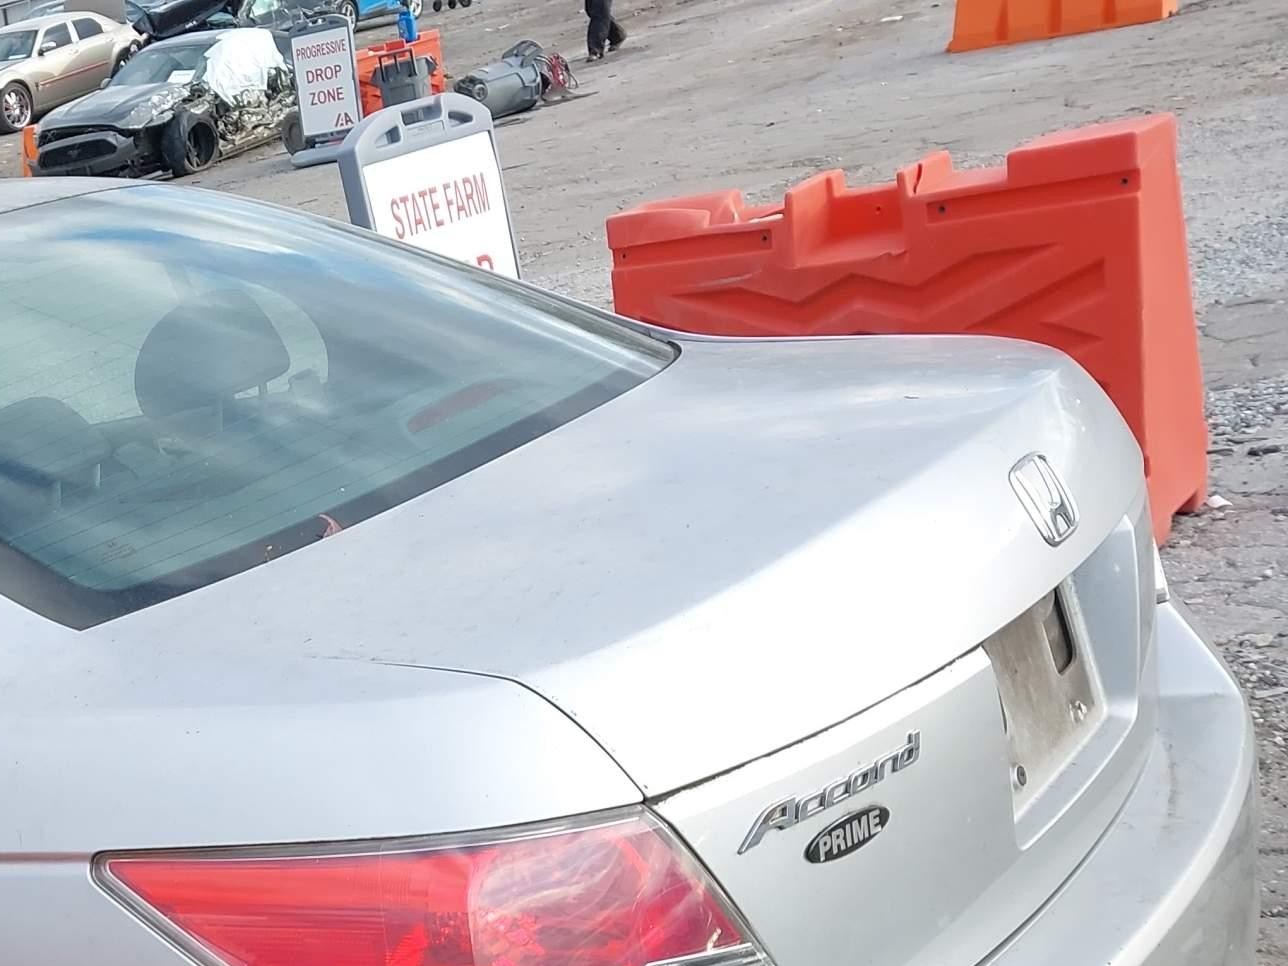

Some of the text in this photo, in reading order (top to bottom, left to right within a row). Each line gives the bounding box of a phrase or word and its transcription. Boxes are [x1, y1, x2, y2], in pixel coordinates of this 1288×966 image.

[296, 39, 347, 61] PROGRESSIVE
[306, 64, 342, 84] DROP
[309, 87, 345, 106] ZONE
[390, 172, 491, 240] STATE FARM
[737, 728, 921, 855] Accord
[818, 808, 883, 862] PRIME
